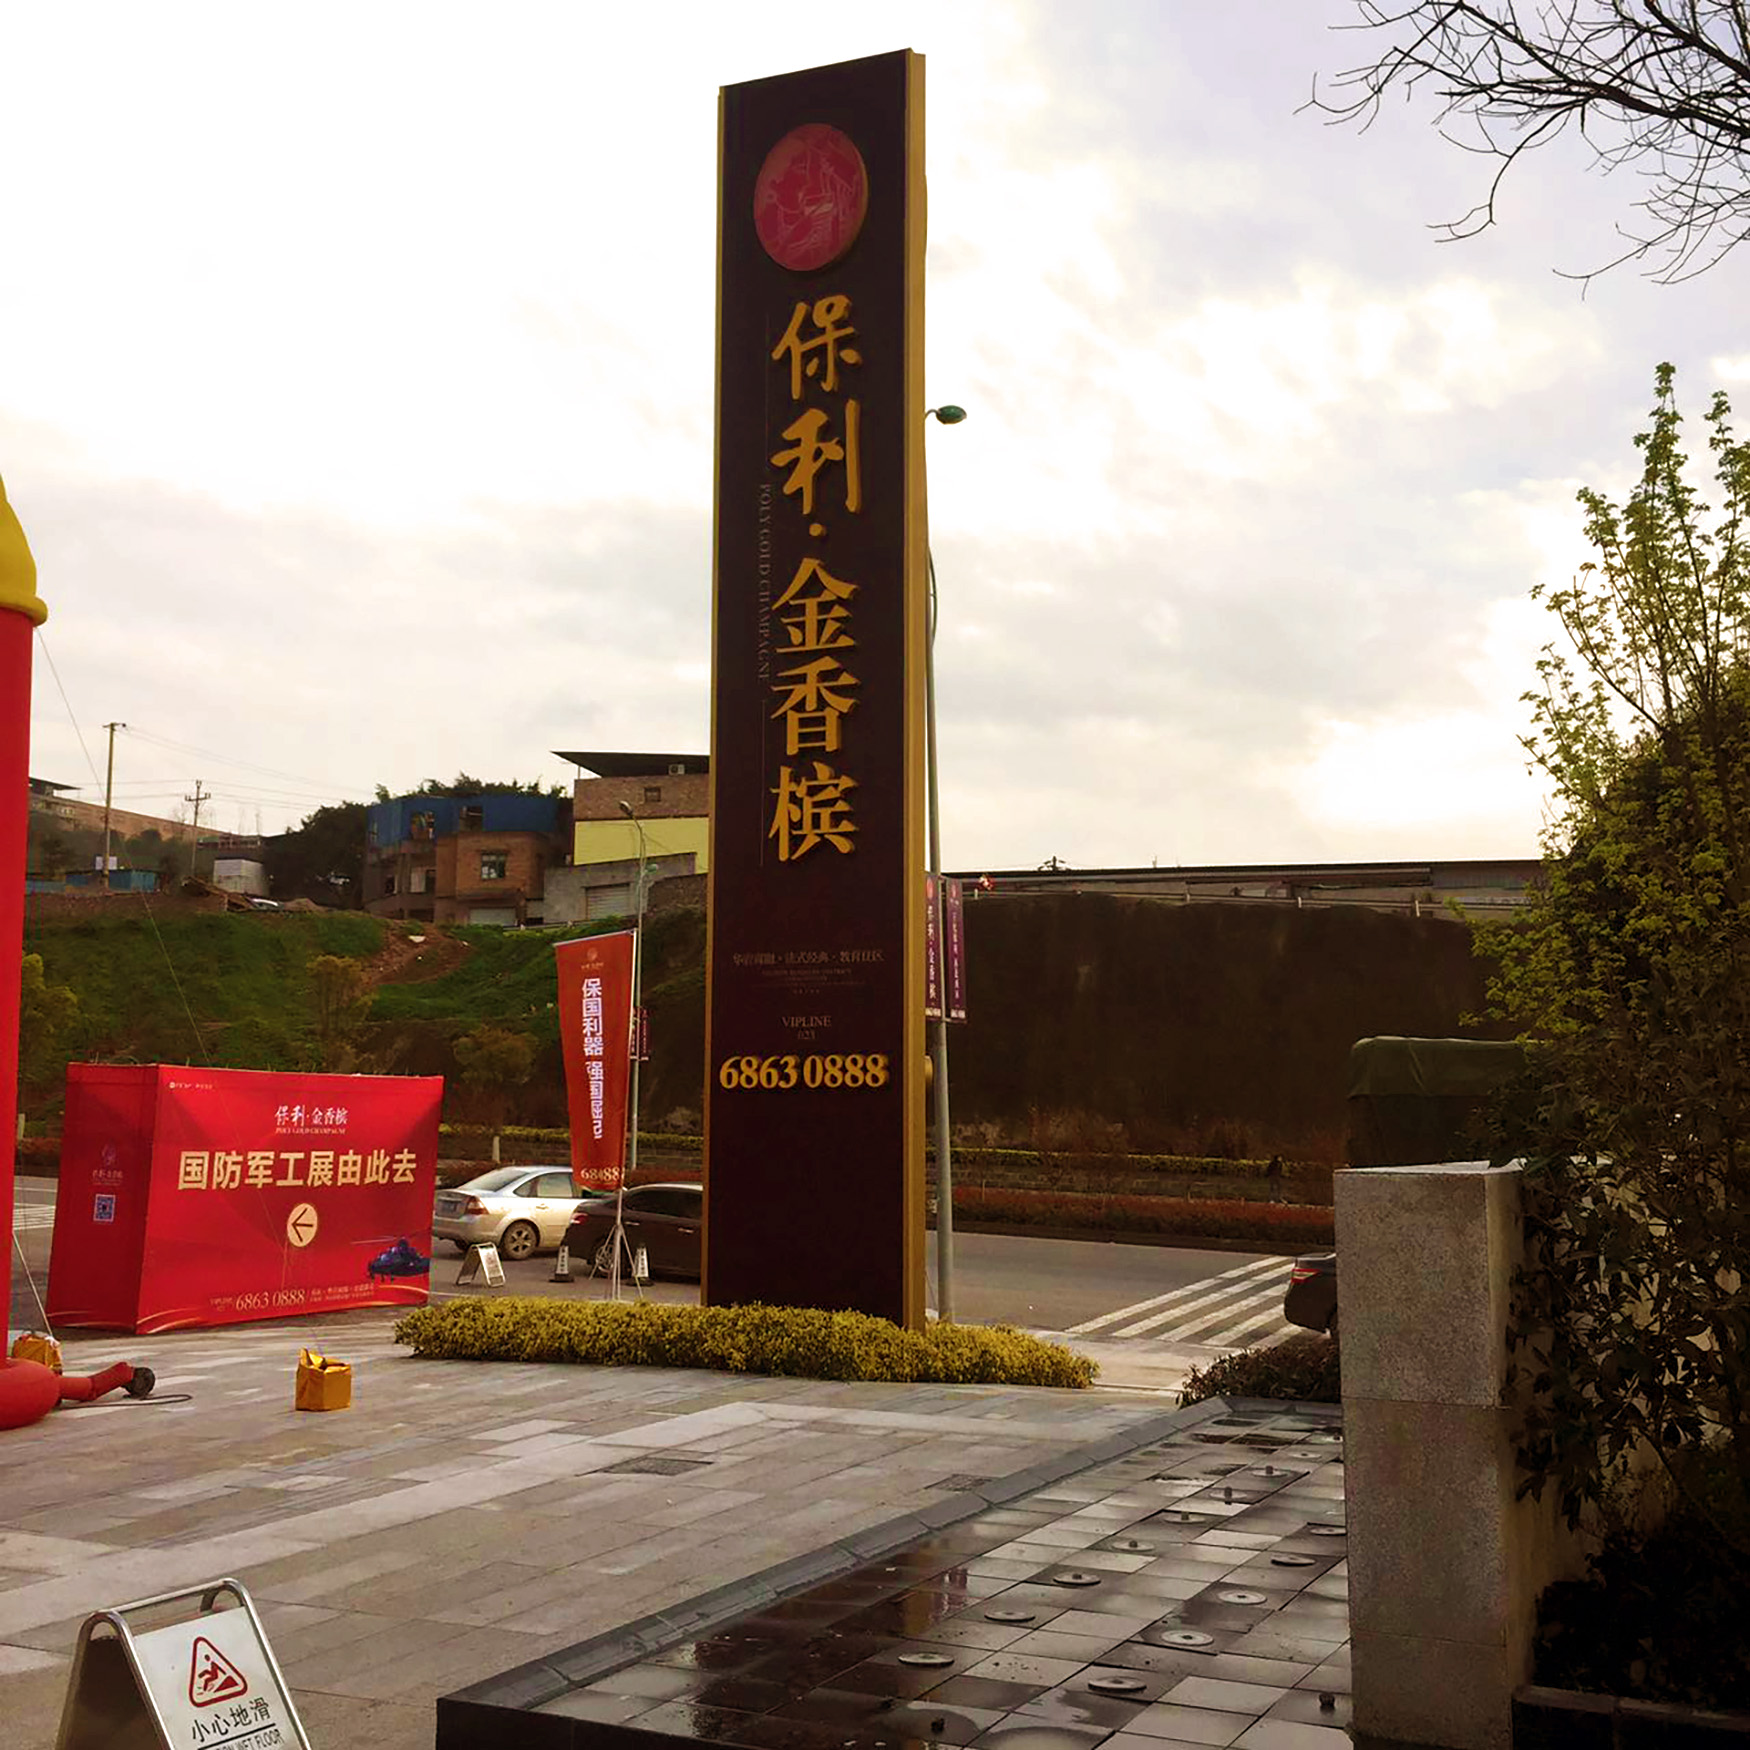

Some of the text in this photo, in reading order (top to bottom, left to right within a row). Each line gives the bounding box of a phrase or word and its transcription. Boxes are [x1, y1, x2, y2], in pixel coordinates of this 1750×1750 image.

[582, 978, 603, 1056] 保国利器
[719, 1053, 891, 1090] 6863 0888
[178, 1148, 417, 1190] 国防军工展由此去
[235, 1291, 270, 1311] 6863
[272, 1288, 306, 1307] 0888
[192, 1697, 271, 1742] 小心地滑
[254, 1729, 285, 1748] FLOOR
